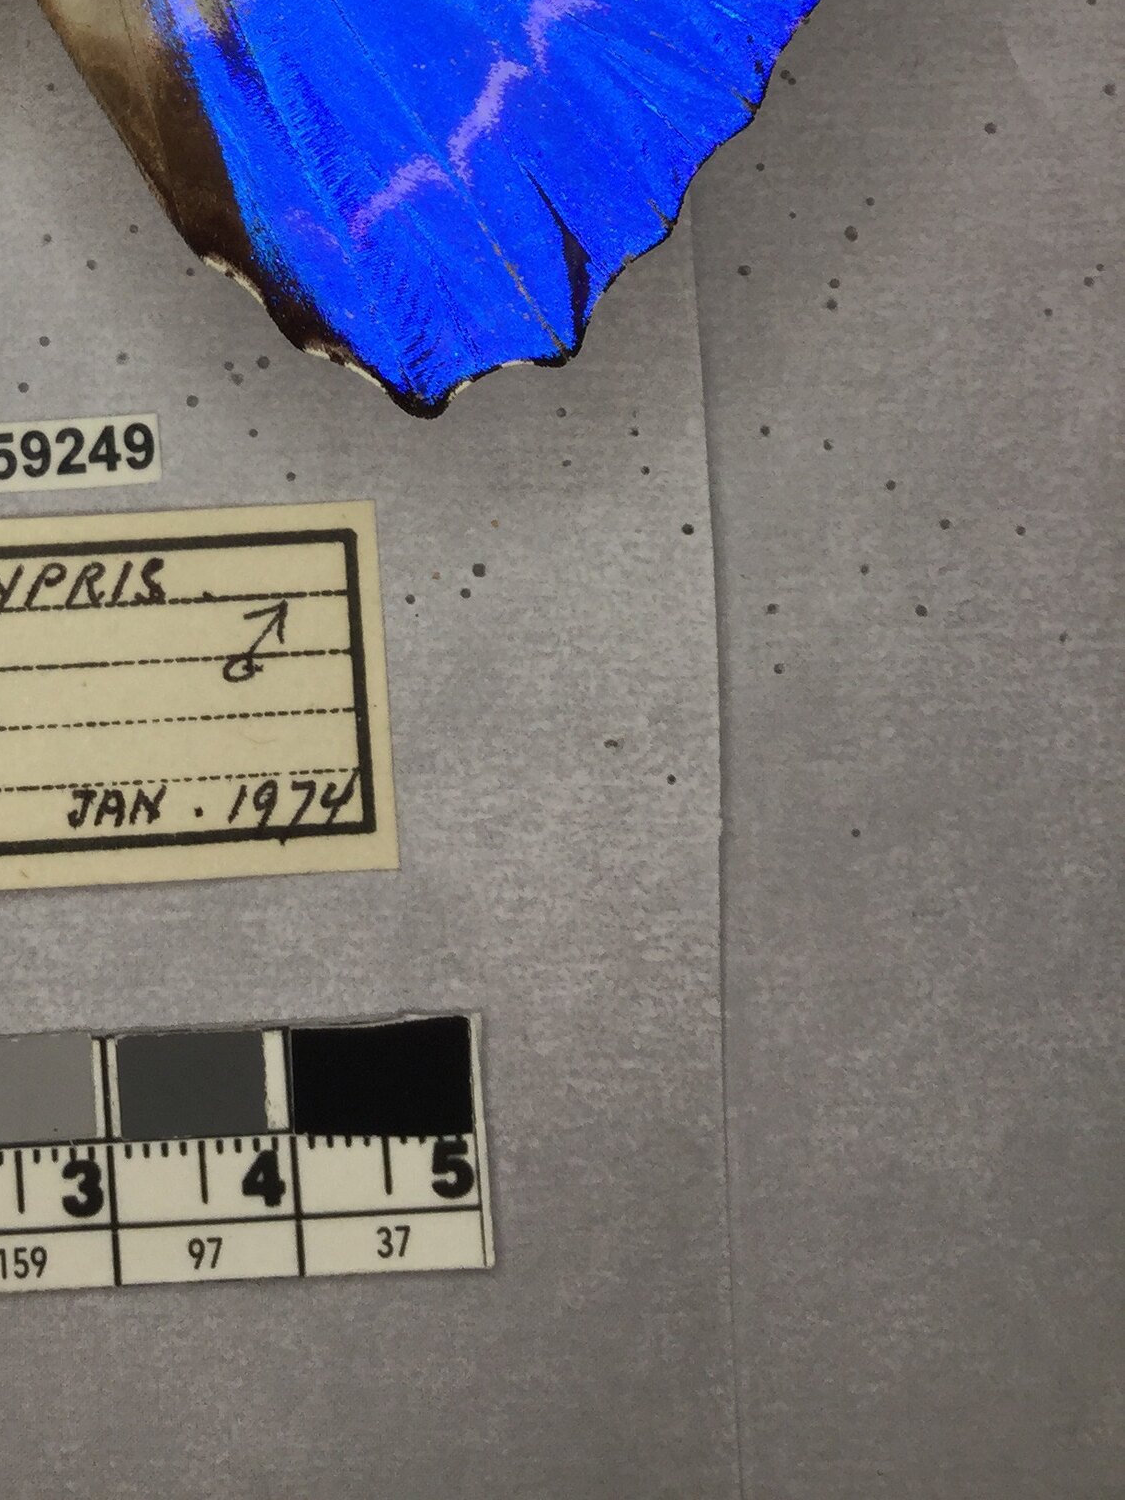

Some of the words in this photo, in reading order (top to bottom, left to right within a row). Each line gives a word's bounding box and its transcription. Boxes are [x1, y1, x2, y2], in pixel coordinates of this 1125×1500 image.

[228, 772, 360, 845] 1974
[61, 1159, 105, 1218] 3
[241, 1149, 286, 1207] 4
[431, 1137, 475, 1199] 5
[187, 1236, 224, 1271] 97
[376, 1224, 411, 1259] 37
